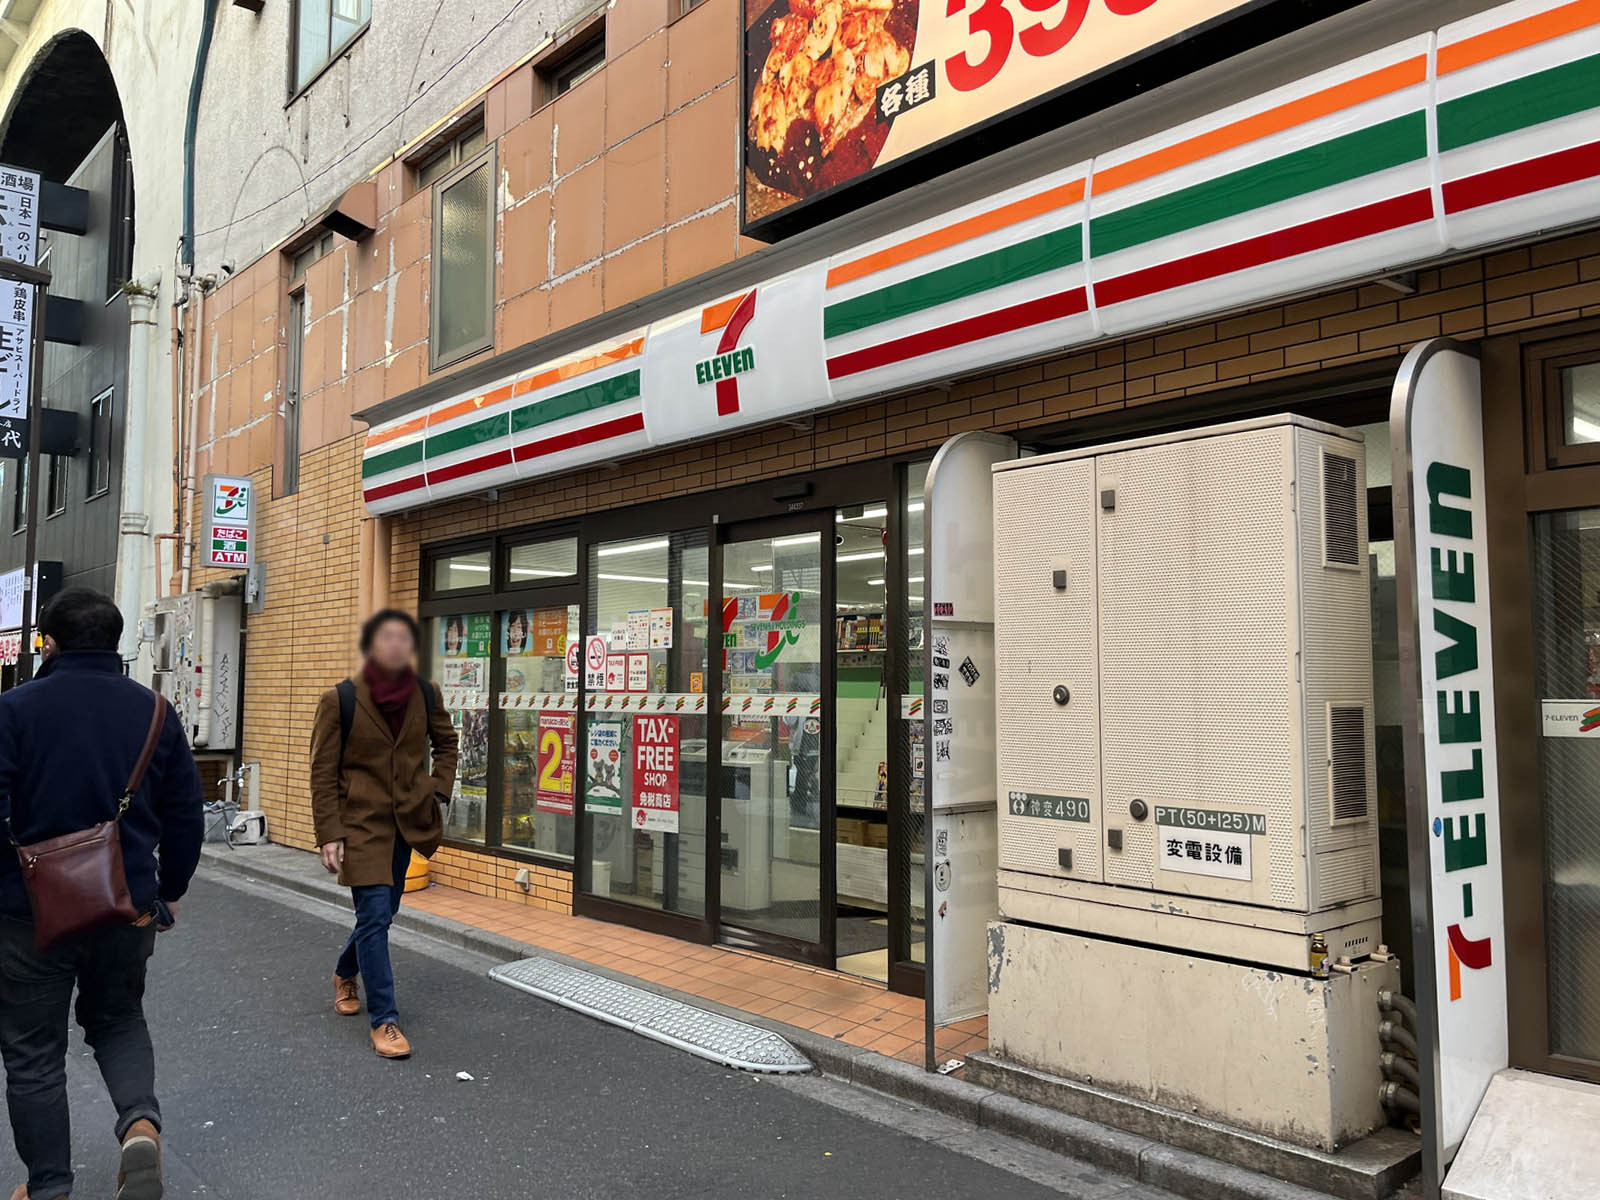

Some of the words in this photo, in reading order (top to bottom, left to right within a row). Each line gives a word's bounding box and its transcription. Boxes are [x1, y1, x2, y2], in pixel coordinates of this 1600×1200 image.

[880, 68, 930, 117] 各種
[1, 172, 34, 191] 酒場
[216, 528, 244, 539] たばこ
[214, 552, 244, 562] ATM
[540, 729, 562, 790] 2
[637, 745, 674, 771] FREE
[643, 772, 668, 787] SHOP
[1166, 838, 1243, 866] 変電設備
